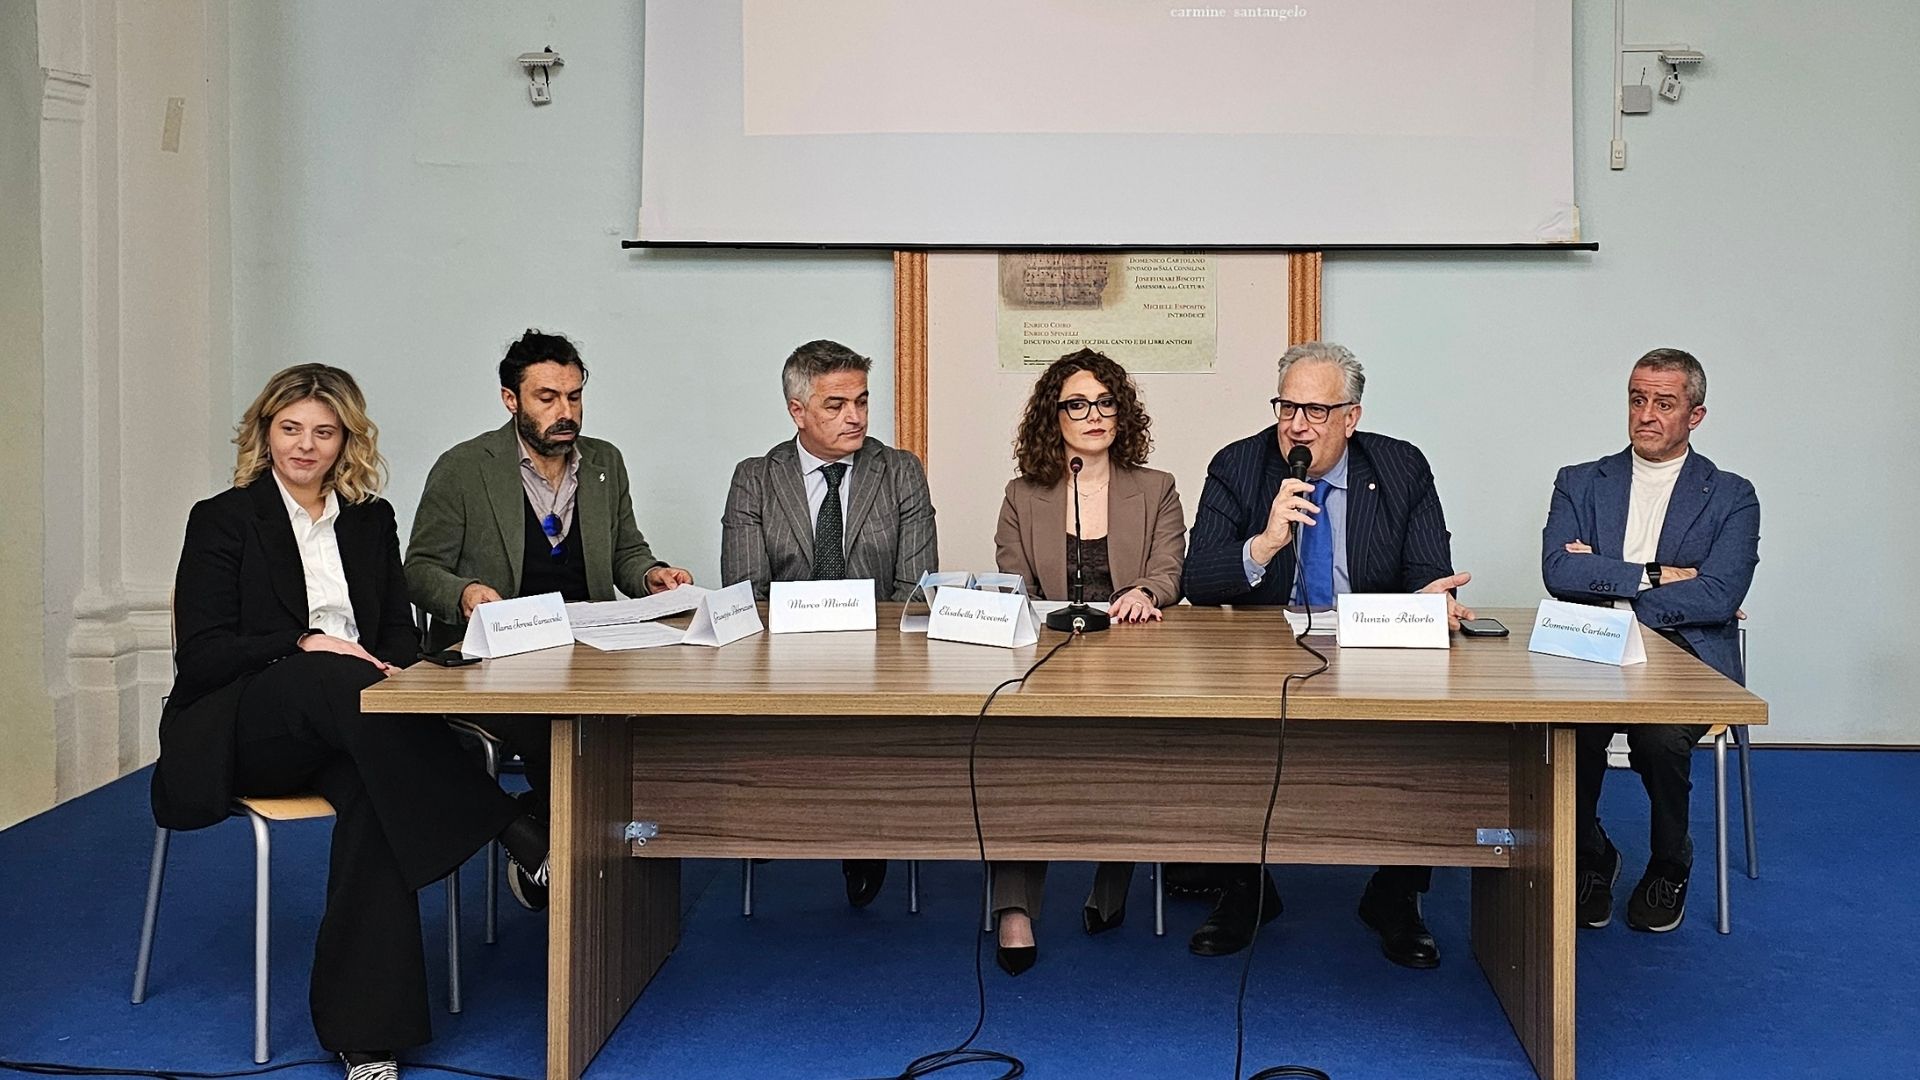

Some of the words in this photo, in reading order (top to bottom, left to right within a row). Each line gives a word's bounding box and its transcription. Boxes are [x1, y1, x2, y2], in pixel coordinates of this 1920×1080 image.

[1170, 7, 1227, 18] carmine
[1233, 4, 1308, 21] santangelo
[787, 598, 820, 609] Marco
[938, 605, 974, 619] Elisabetta
[1352, 611, 1391, 623] Nunzio
[1395, 611, 1435, 623] Ritorto
[1541, 616, 1581, 632] Domenico
[1581, 623, 1621, 639] Cartolano
